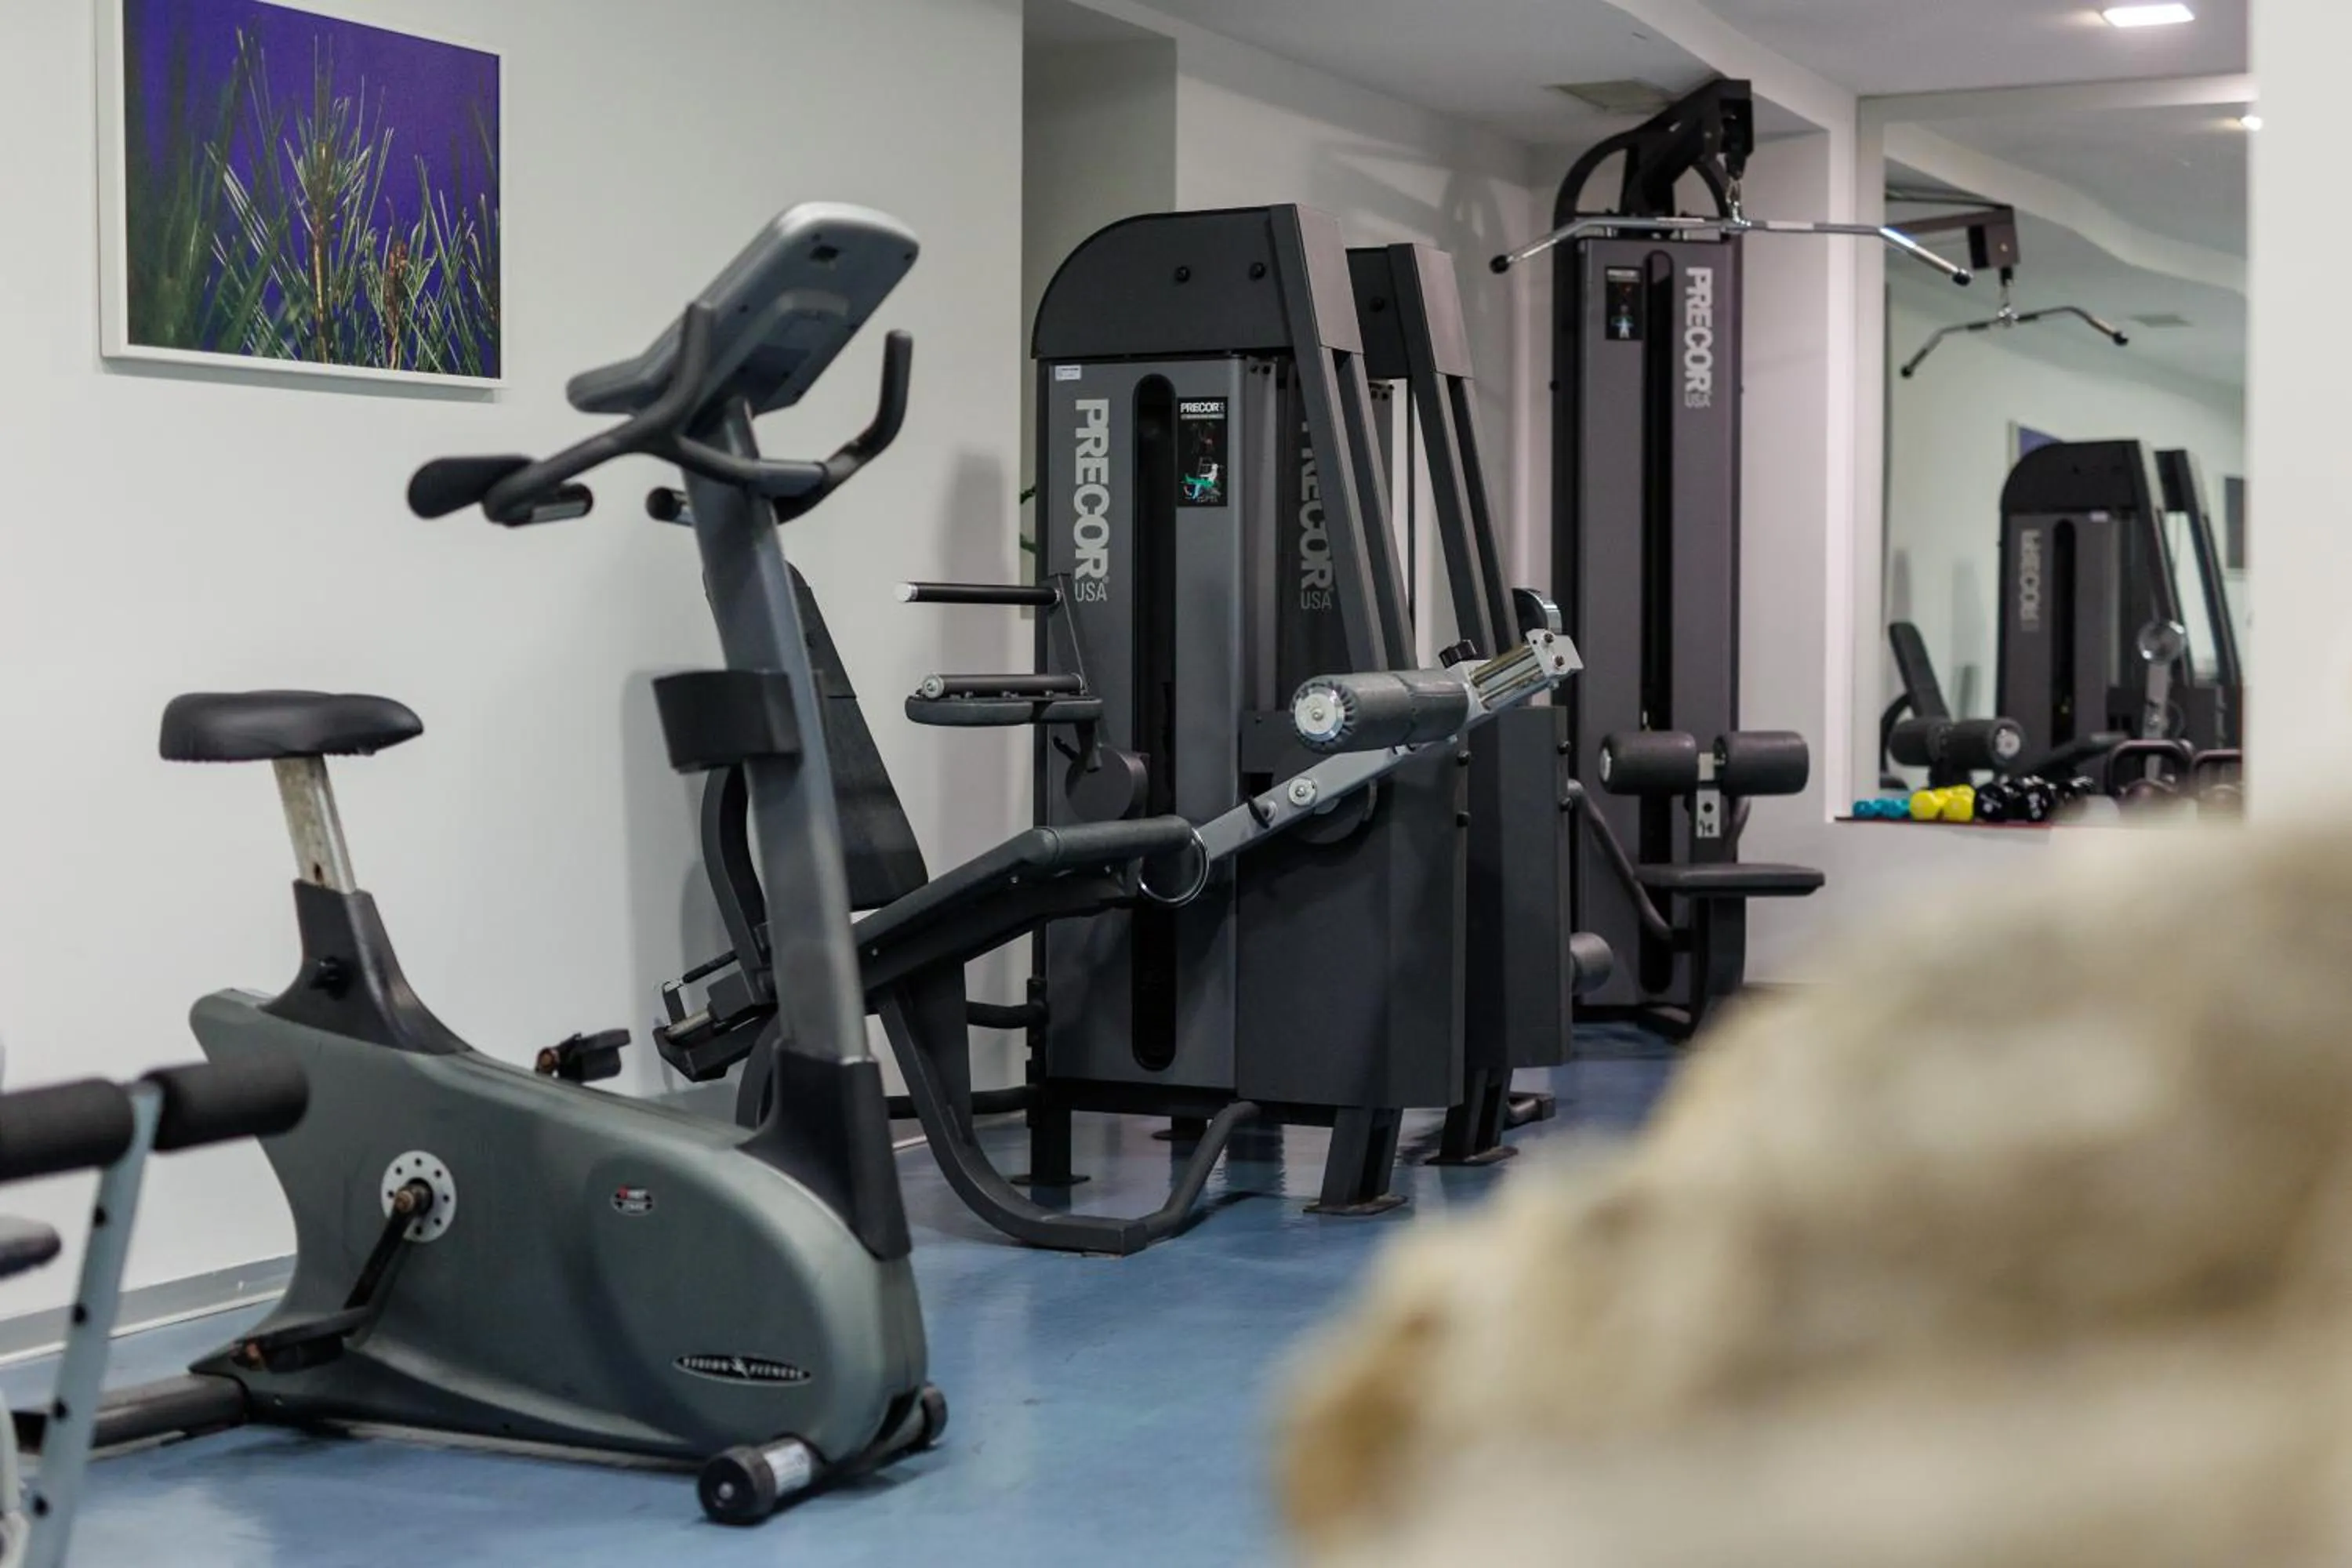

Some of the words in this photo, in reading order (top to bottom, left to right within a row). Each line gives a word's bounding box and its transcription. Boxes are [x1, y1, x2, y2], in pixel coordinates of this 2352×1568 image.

[1684, 267, 1713, 392] PRECOR
[1180, 402, 1220, 413] PRECOR
[1073, 398, 1110, 579] PRECOR
[1299, 421, 1334, 590] ECOR
[1075, 582, 1107, 602] USA
[1301, 590, 1333, 610] USA
